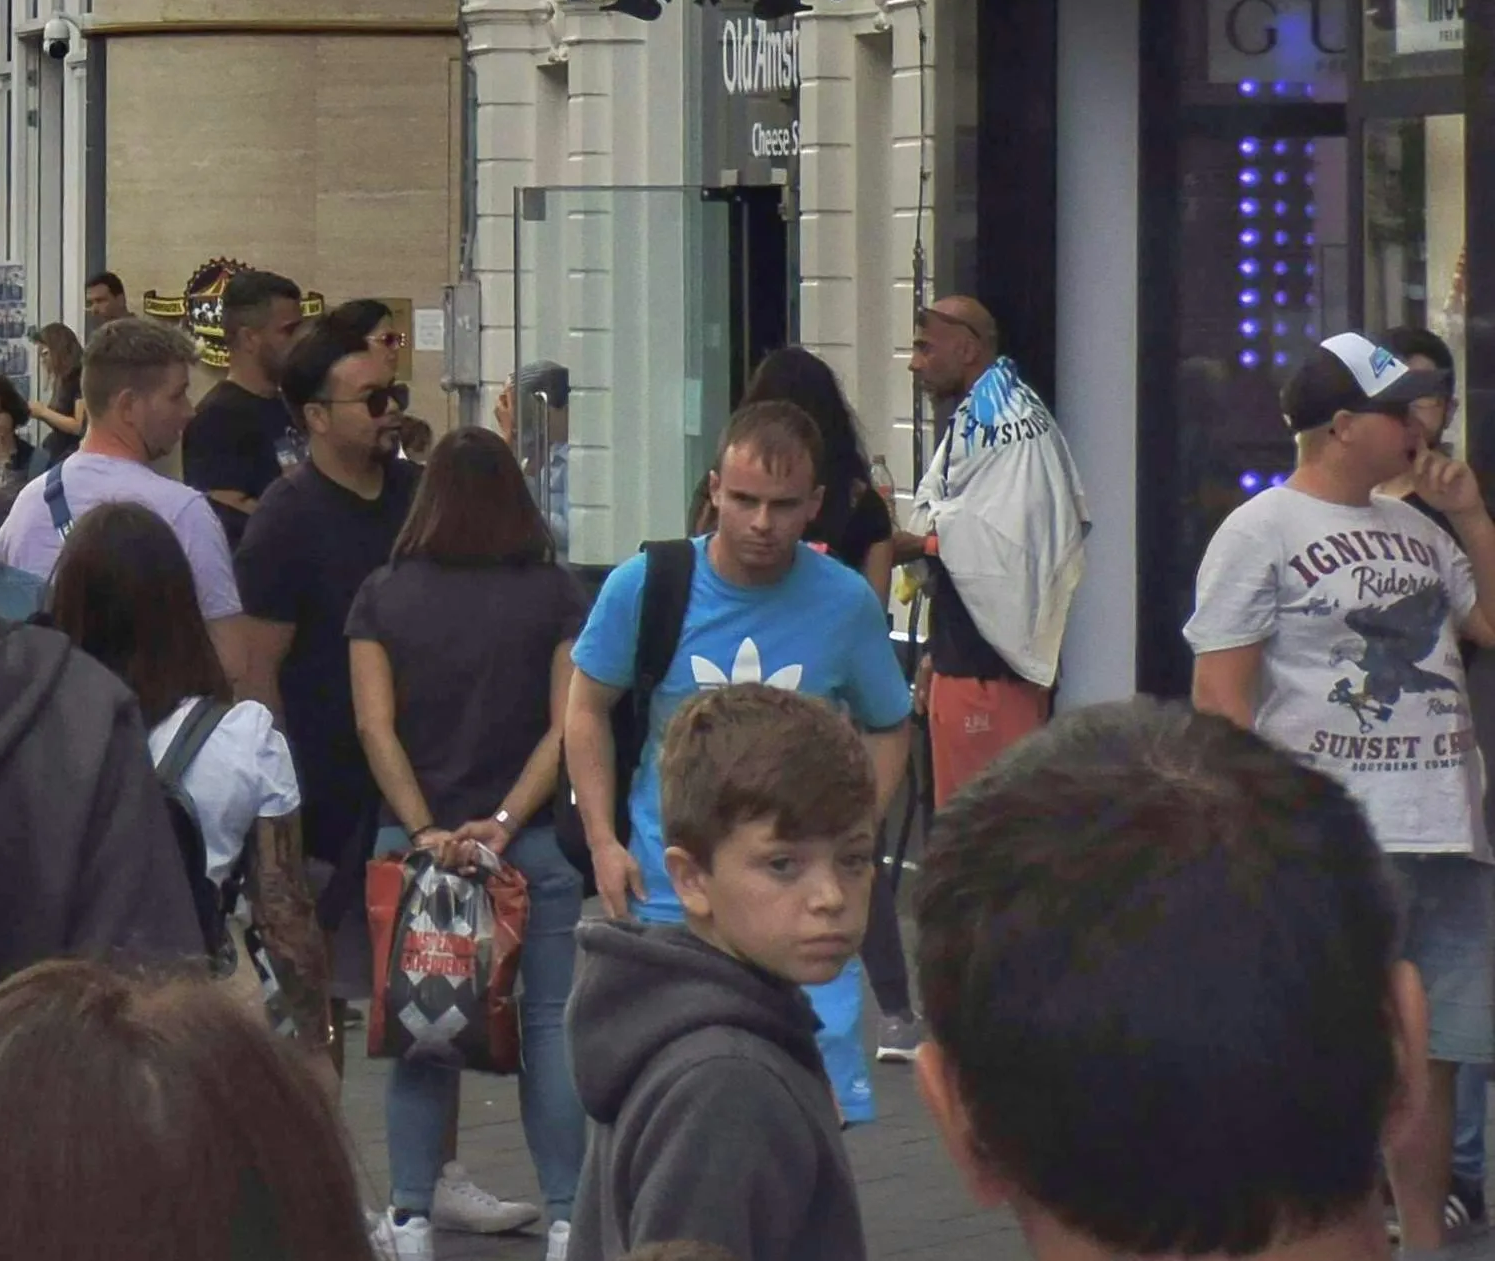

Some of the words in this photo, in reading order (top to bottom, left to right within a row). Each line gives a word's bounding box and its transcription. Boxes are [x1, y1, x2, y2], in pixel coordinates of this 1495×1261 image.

[722, 18, 752, 94] Old
[752, 121, 791, 157] Cheese
[1309, 729, 1421, 760] SUNSET
